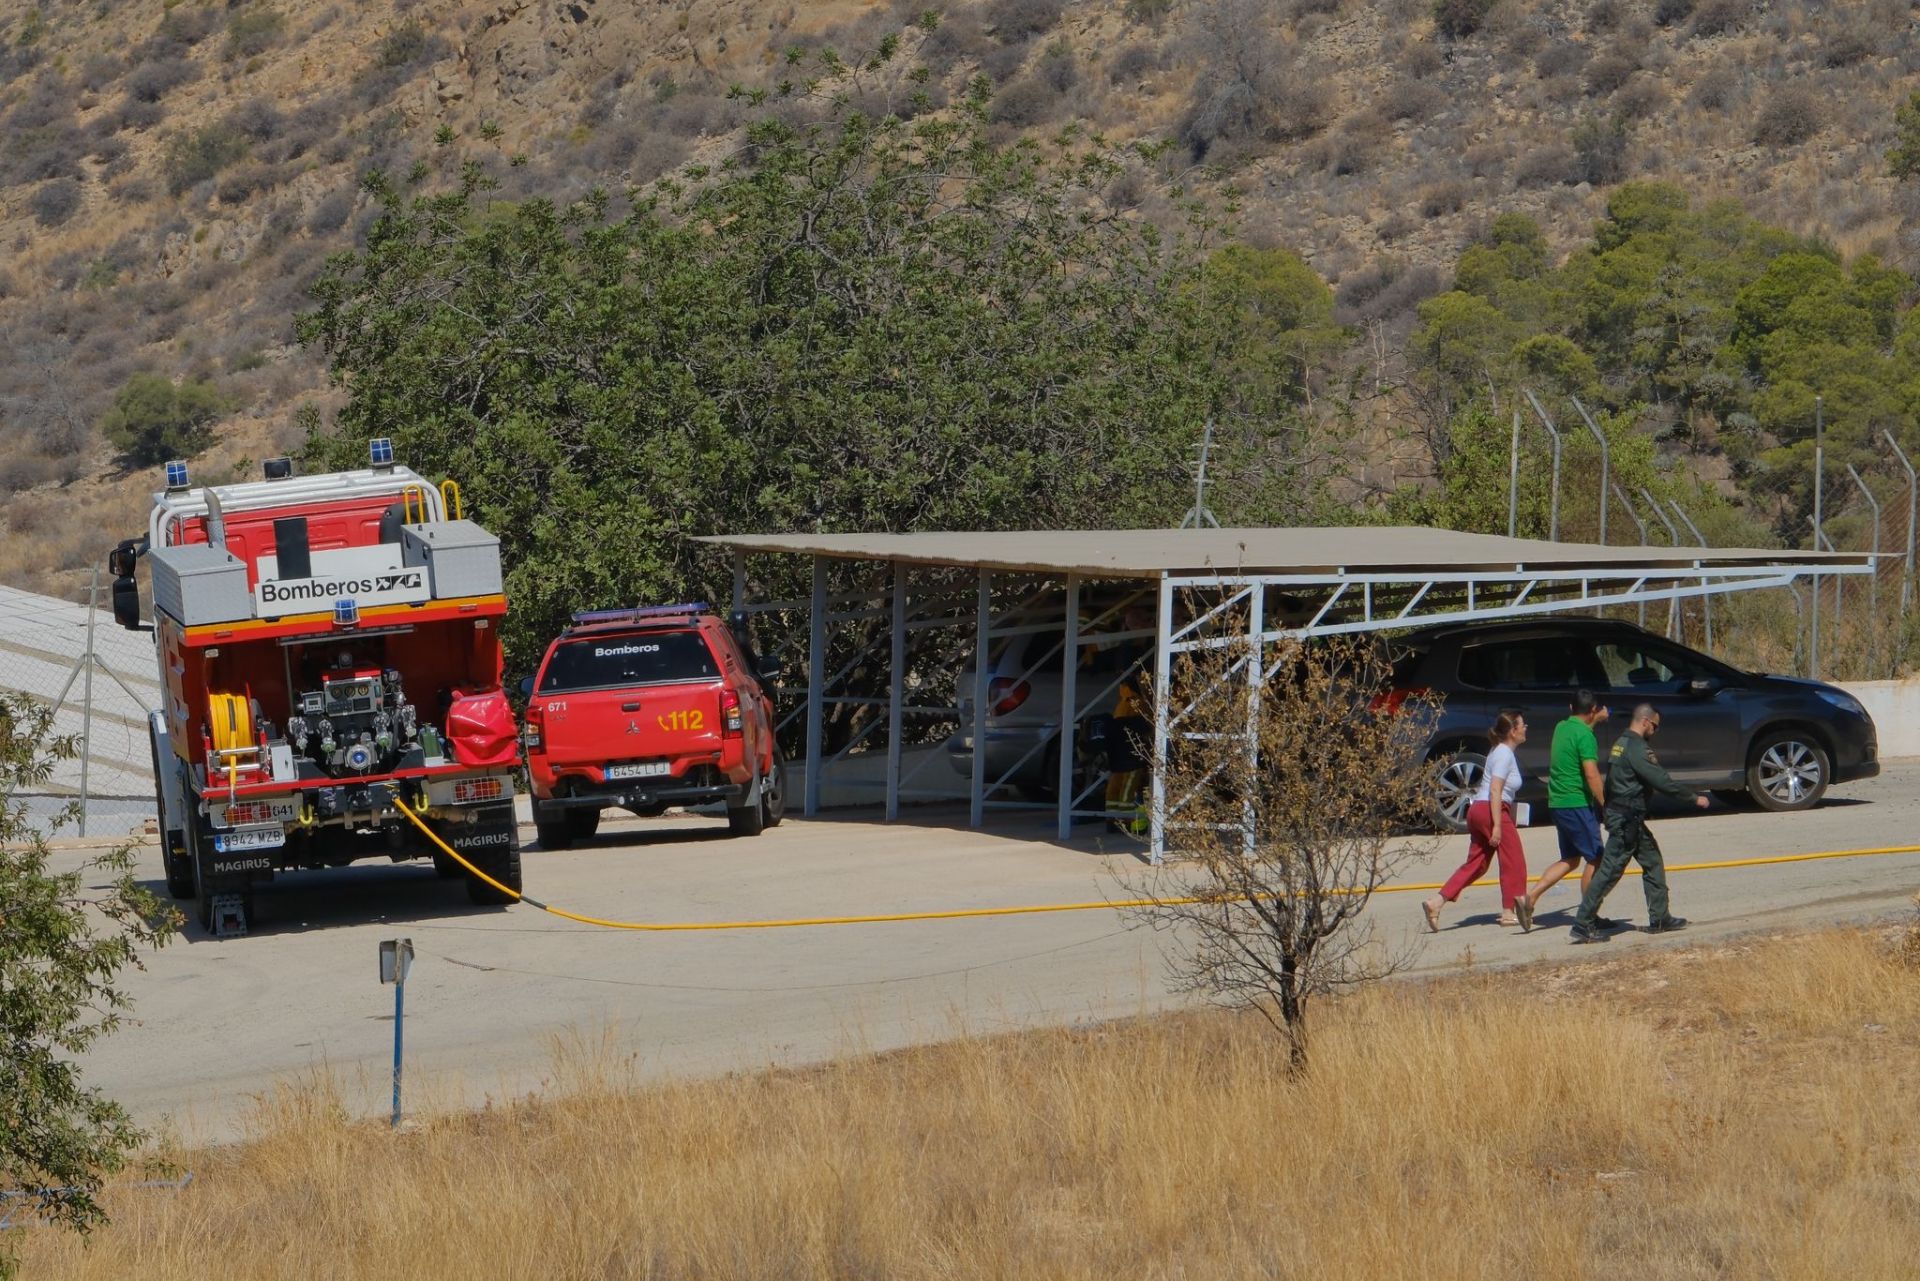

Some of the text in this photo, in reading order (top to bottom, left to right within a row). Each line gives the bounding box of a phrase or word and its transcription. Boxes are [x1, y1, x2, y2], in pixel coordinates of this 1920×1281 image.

[262, 579, 373, 603] Bomberos
[595, 644, 660, 657] Bomberos
[548, 702, 567, 712] 671
[668, 709, 704, 730] 112
[613, 764, 641, 777] 6454
[223, 834, 254, 847] 8942
[454, 833, 510, 848] MAGIRUS
[214, 858, 271, 872] MAGIRUS
